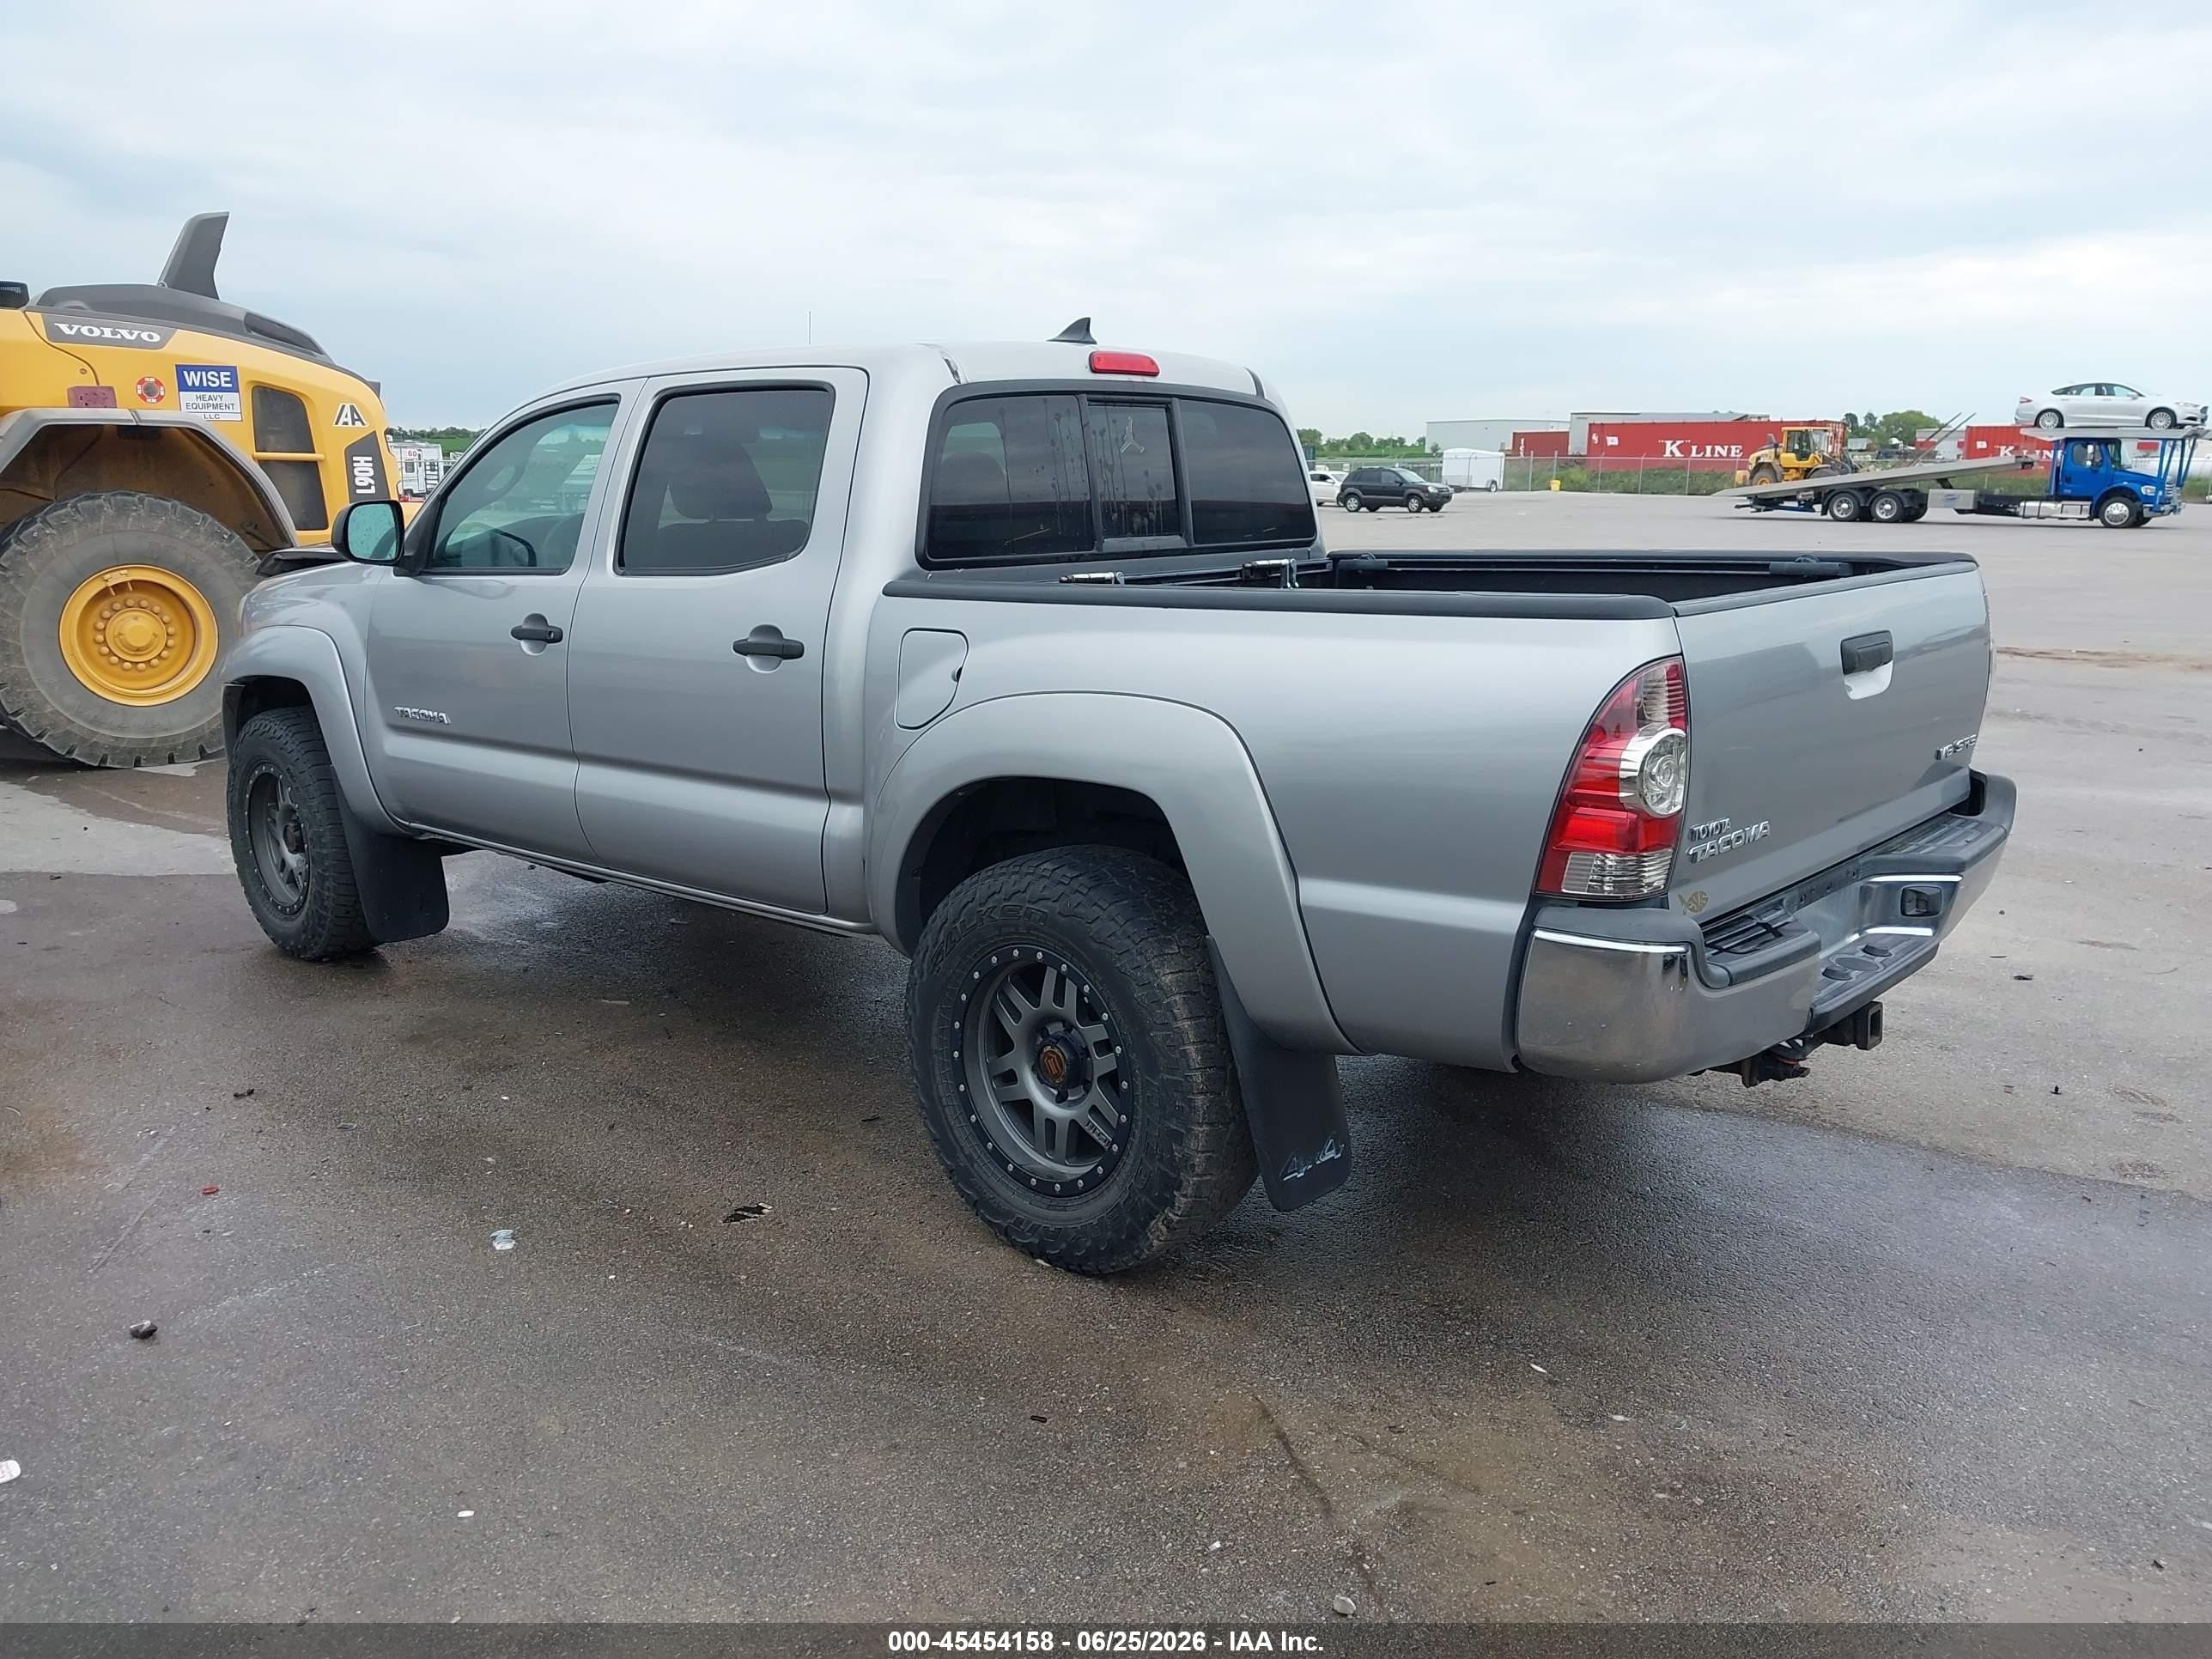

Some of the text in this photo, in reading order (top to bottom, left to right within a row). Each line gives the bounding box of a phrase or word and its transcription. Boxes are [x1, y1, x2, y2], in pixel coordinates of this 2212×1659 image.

[54, 323, 161, 342] VOLVO
[183, 370, 233, 387] WISE
[185, 402, 235, 410] EQUIPMENT
[1691, 445, 1743, 457] LINE
[393, 706, 452, 725] TACOMA
[1689, 817, 1731, 842] TOYOTA
[1686, 820, 1771, 863] TACOMA
